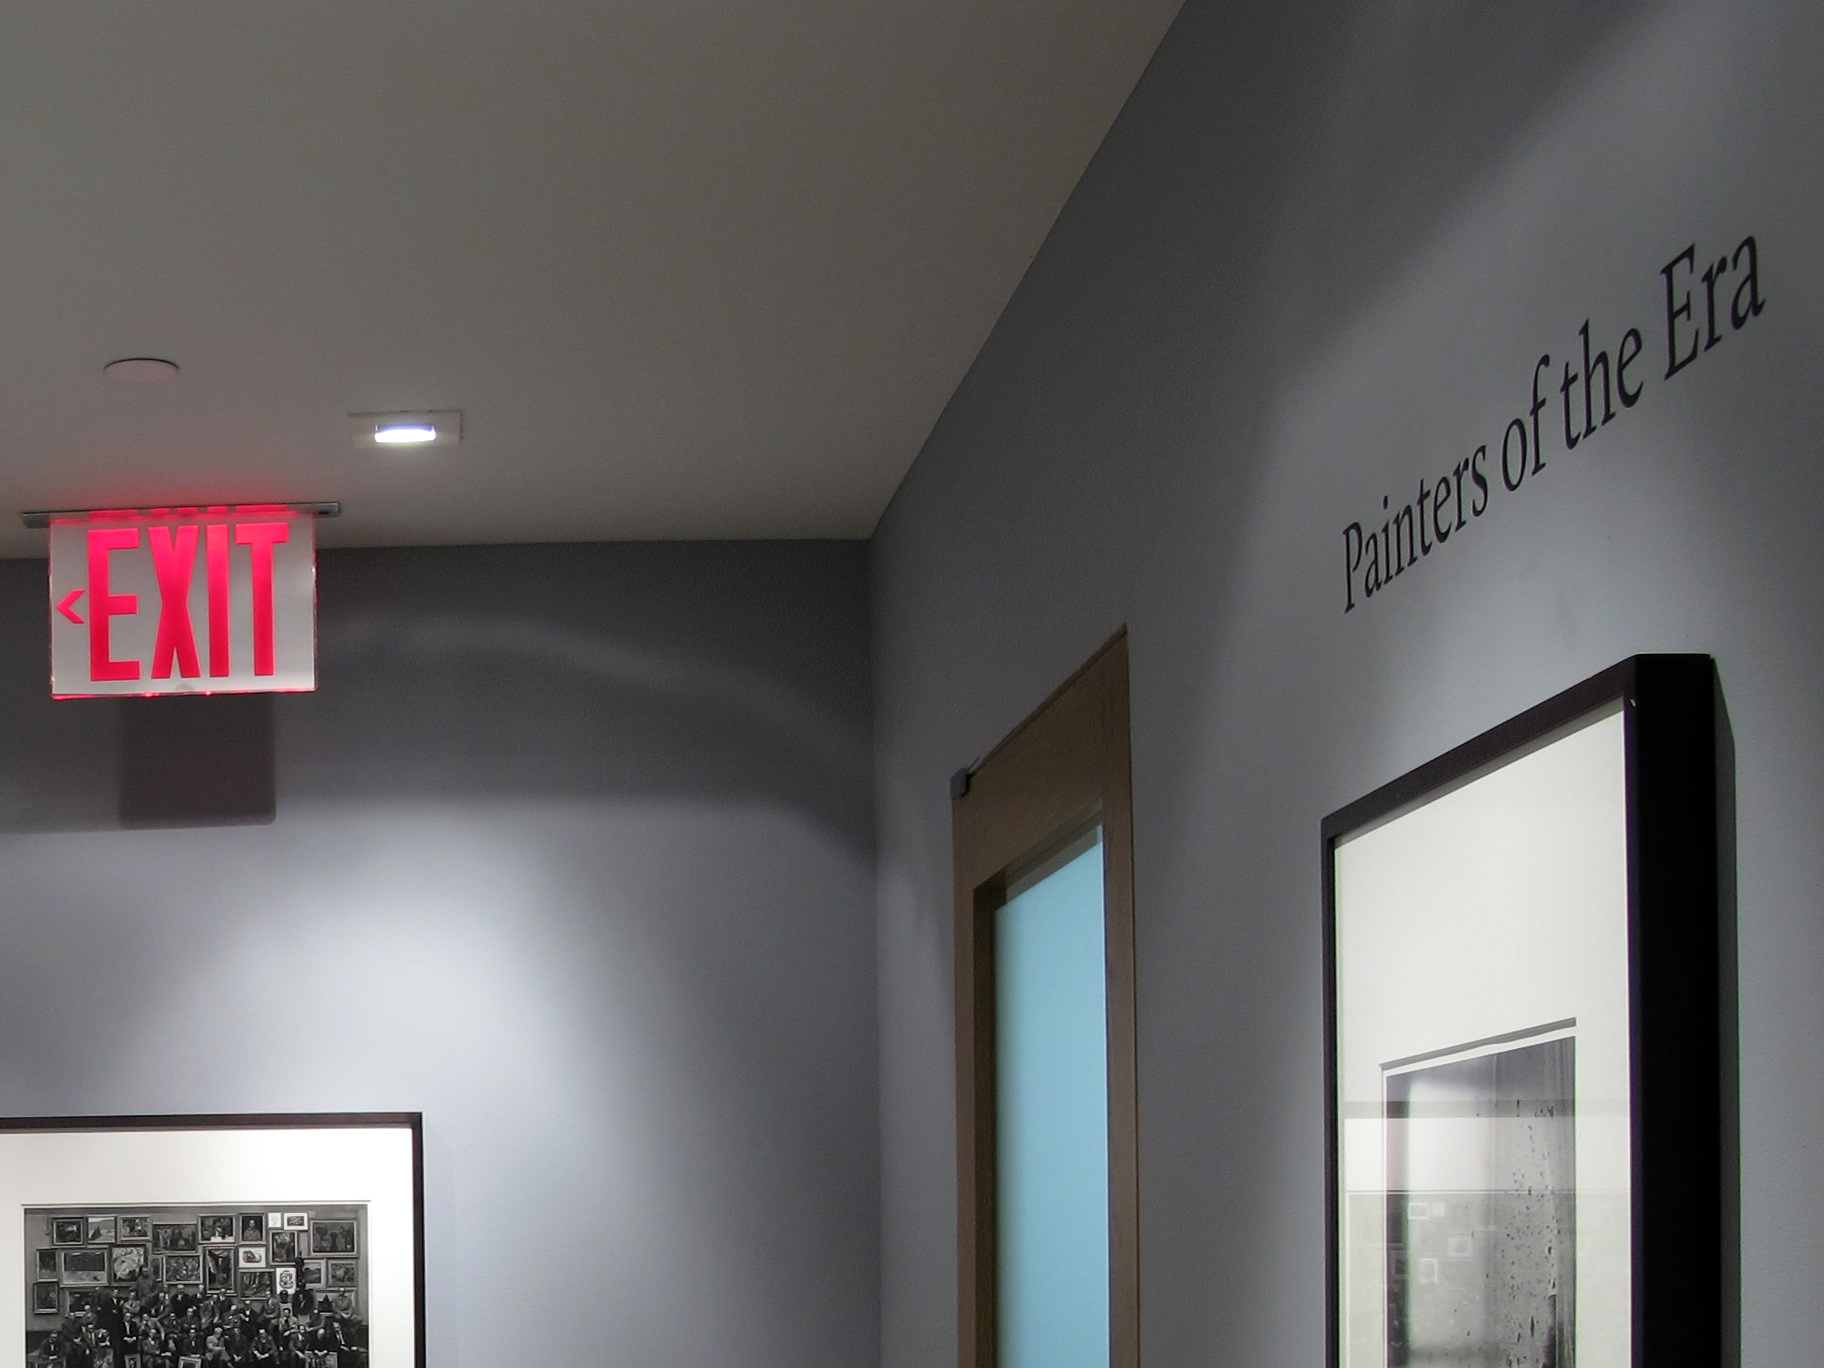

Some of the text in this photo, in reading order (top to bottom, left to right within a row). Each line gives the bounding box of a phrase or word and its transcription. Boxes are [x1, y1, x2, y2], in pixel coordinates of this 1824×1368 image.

[1341, 235, 1767, 615] Painters of the Era
[87, 522, 290, 681] EXIT
